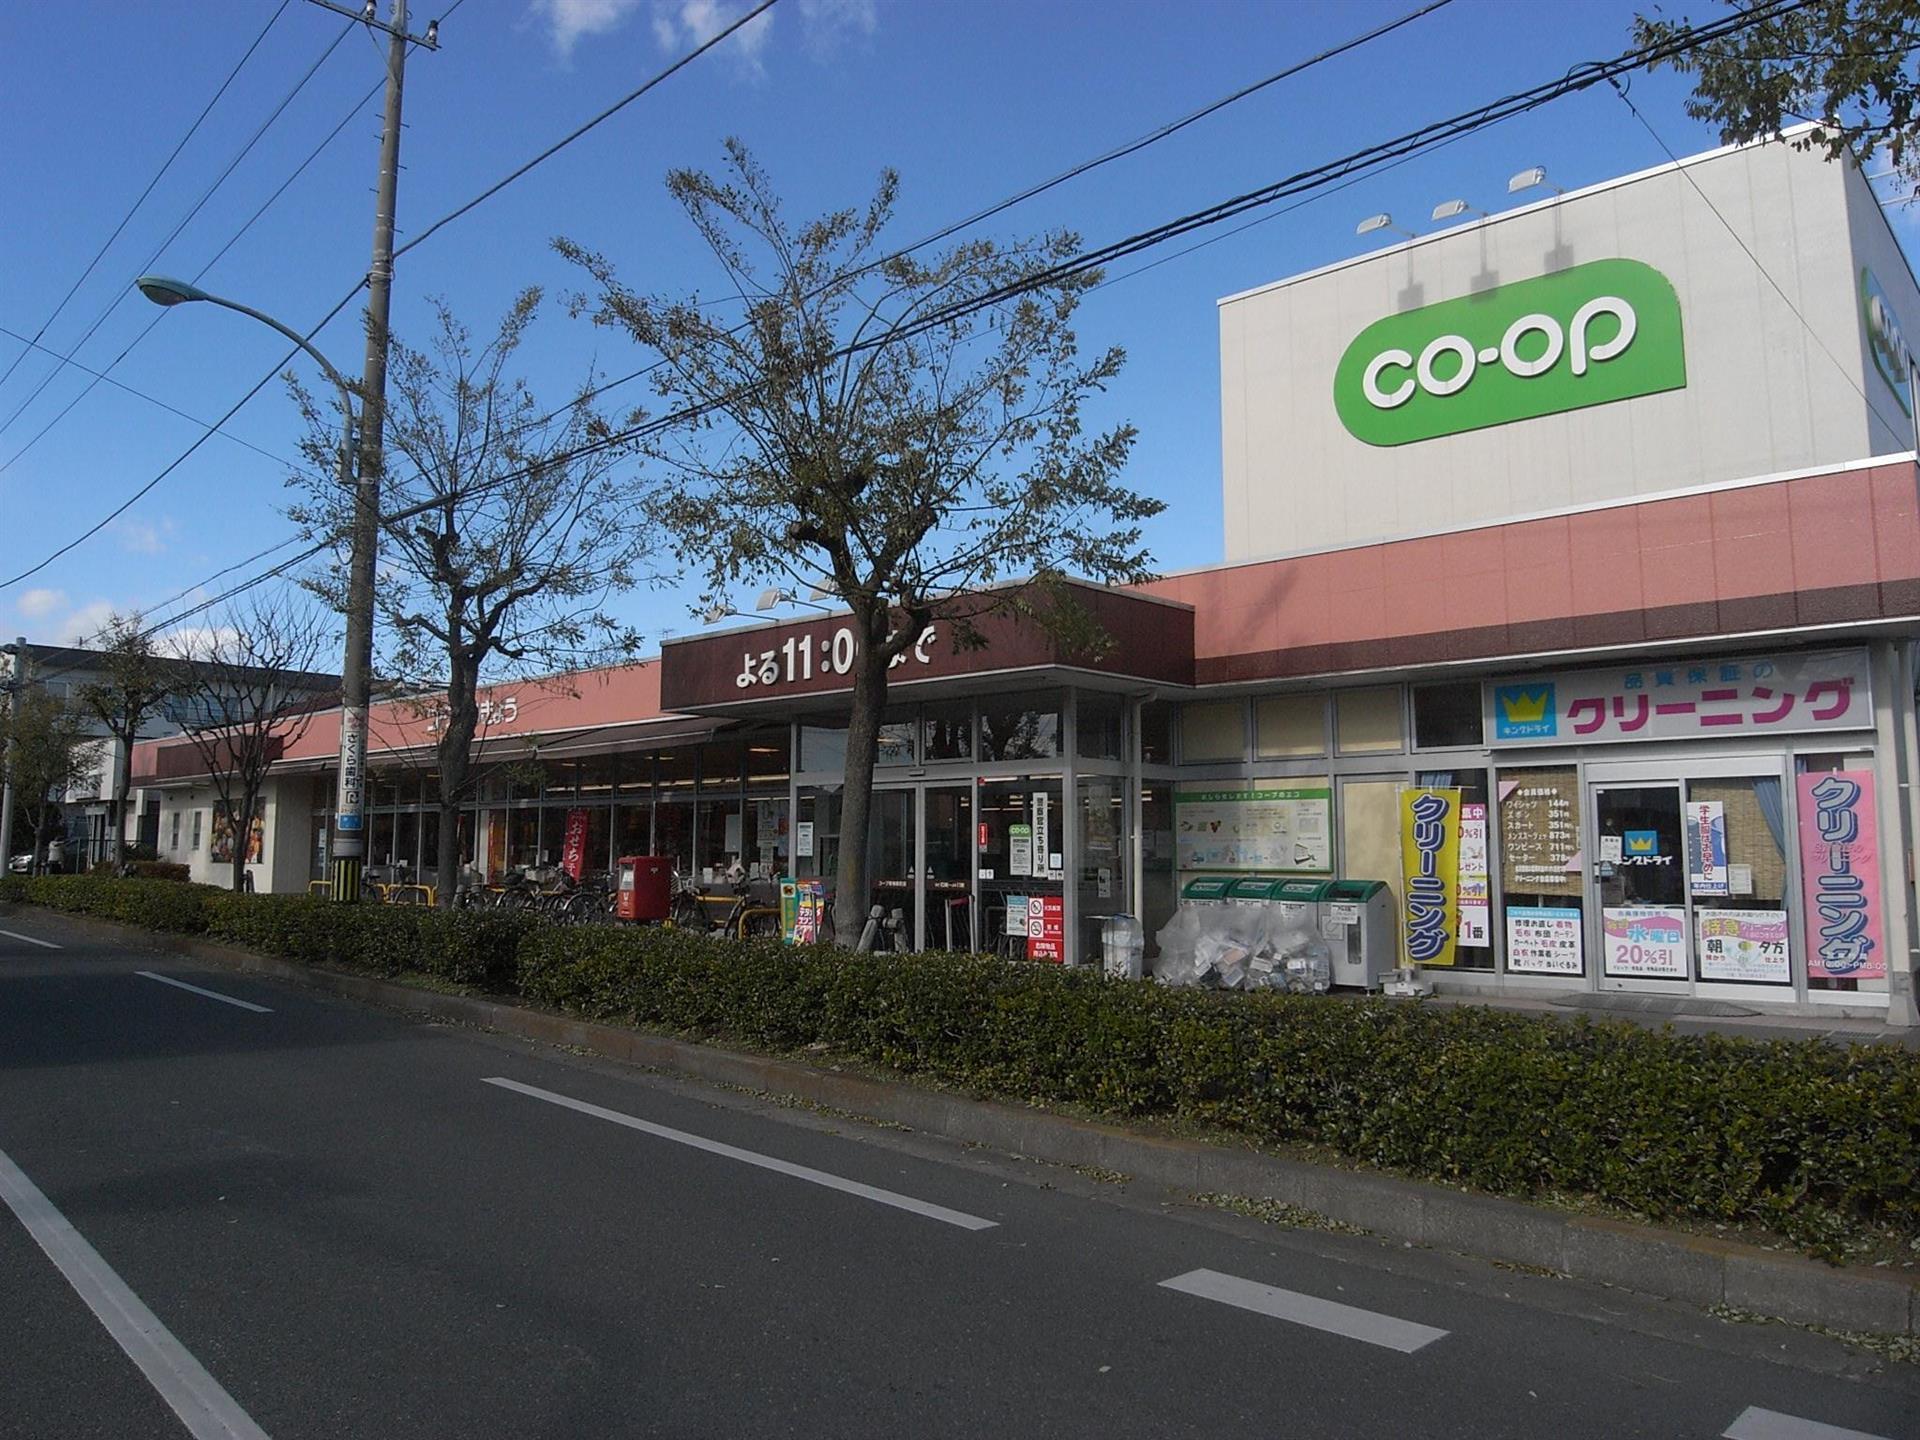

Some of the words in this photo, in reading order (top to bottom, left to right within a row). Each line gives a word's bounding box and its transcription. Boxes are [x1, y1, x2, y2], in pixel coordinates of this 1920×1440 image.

[1362, 296, 1637, 409] co-op
[1624, 661, 1774, 689] 品質保証の
[1567, 677, 1854, 734] クリーニング
[1503, 725, 1549, 735] キングドライ
[1506, 801, 1537, 809] ワイシャツ
[1507, 843, 1543, 851] ワンピース
[1699, 805, 1714, 881] 学生服はお早めに
[1508, 854, 1536, 862] セーター
[1613, 856, 1673, 866] キングドライ
[1405, 794, 1450, 960] クリーニング
[1812, 777, 1875, 975] クリーニング
[1627, 925, 1681, 943] 水曜日
[1616, 945, 1673, 966] 20%引
[1706, 939, 1723, 953] 朝
[1759, 941, 1785, 954] 夕方
